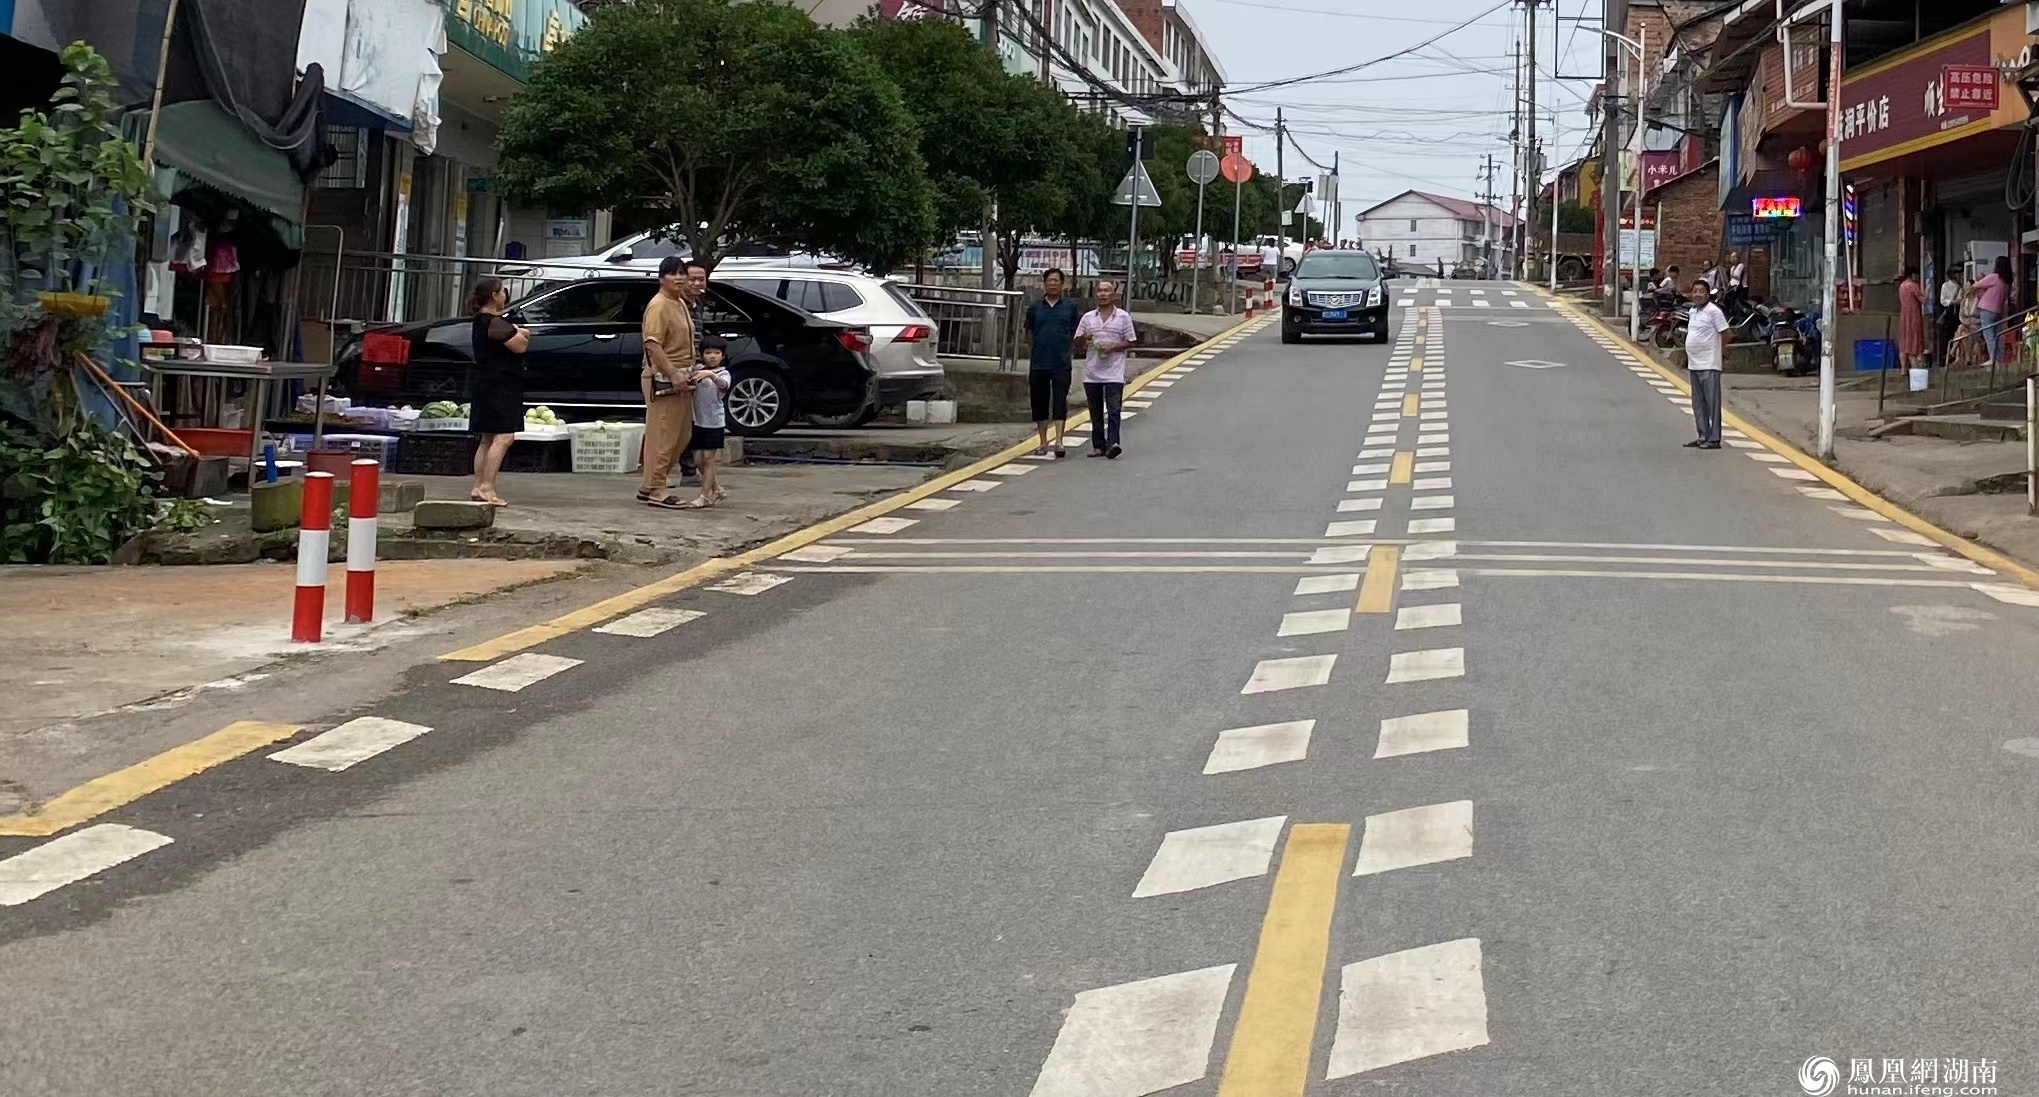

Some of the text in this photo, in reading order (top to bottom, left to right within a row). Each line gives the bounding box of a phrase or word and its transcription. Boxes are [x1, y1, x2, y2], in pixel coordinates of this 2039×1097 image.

[1950, 71, 1993, 85] 高压危险
[1950, 87, 1993, 101] 禁止靠近
